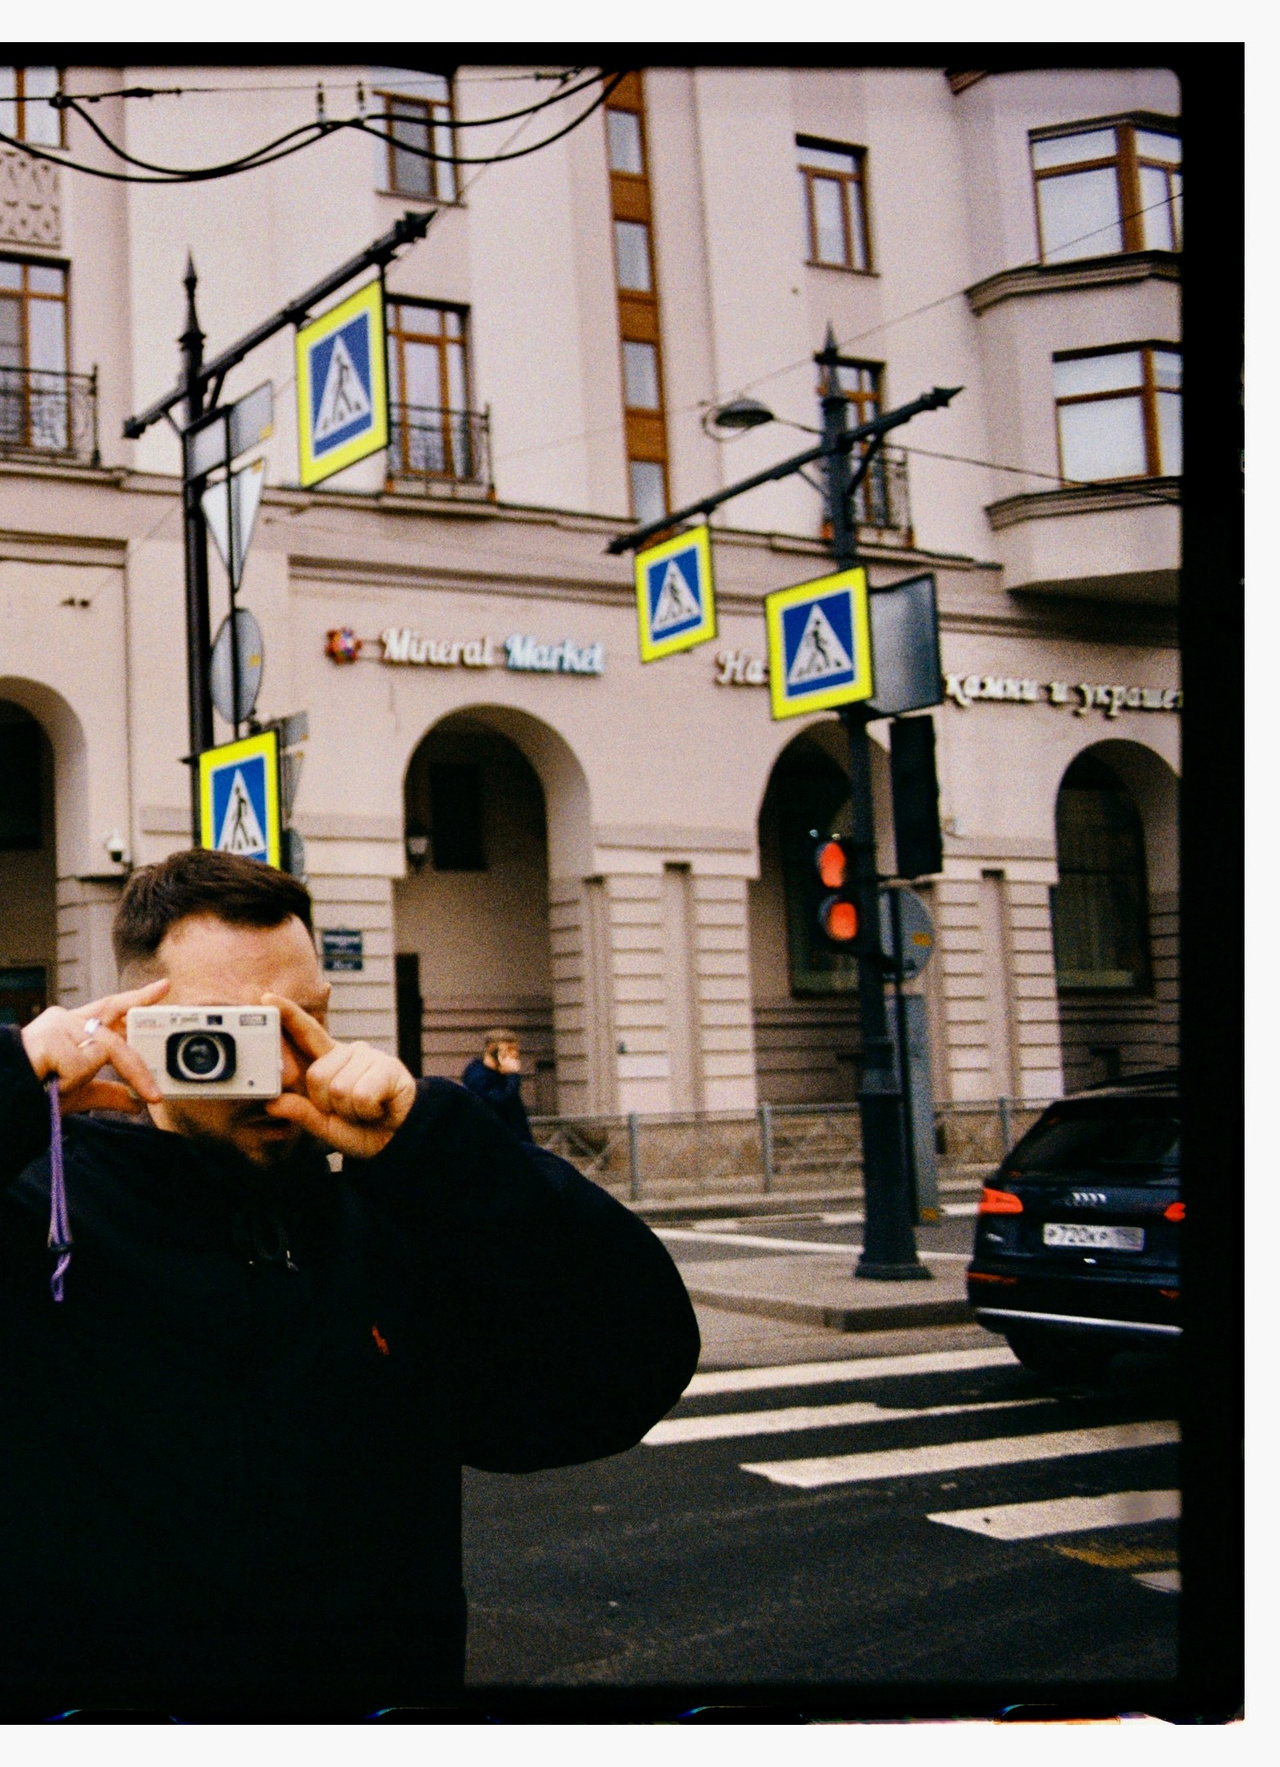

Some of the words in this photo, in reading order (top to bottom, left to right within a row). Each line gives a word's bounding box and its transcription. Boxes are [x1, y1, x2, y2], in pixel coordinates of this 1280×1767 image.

[381, 627, 494, 666] Mineral
[506, 633, 605, 674] Market
[1048, 681, 1068, 703] и
